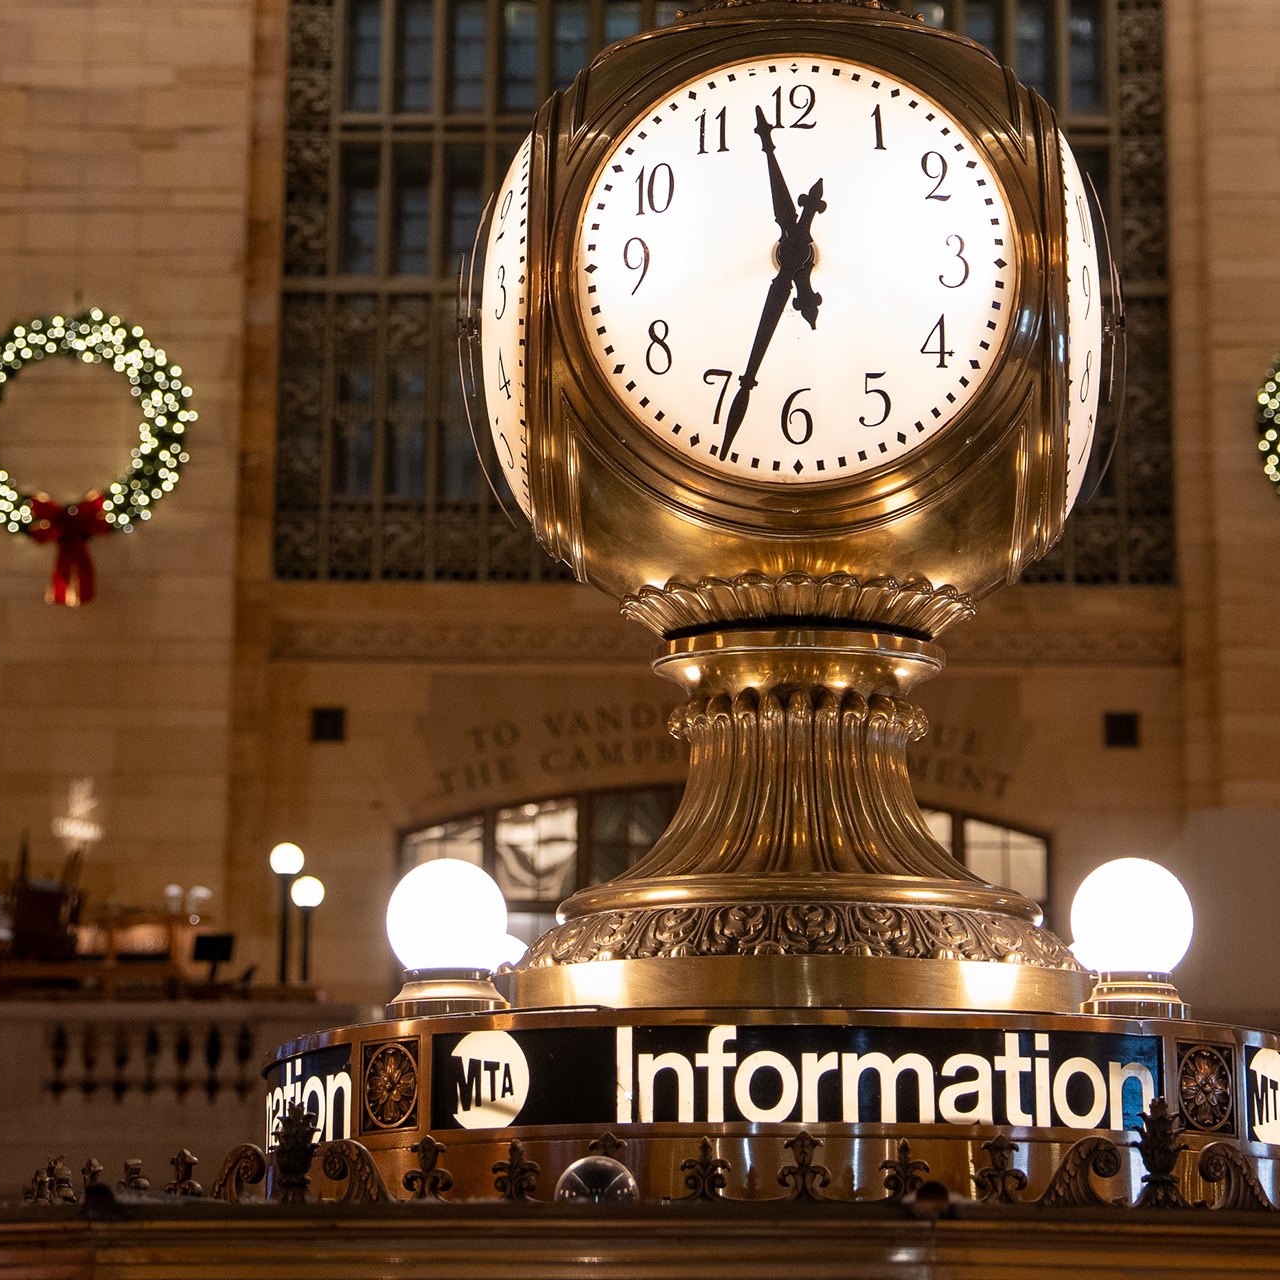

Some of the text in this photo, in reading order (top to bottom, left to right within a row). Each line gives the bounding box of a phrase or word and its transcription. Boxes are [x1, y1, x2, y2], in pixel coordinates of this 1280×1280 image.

[694, 106, 730, 155] 11
[771, 84, 817, 130] 12
[870, 103, 888, 150] 1
[635, 162, 675, 216] 10
[920, 150, 952, 202] 2
[623, 236, 650, 295] 9
[937, 233, 970, 290] 3
[494, 264, 507, 321] 3
[1081, 265, 1092, 321] 9
[645, 319, 673, 375] 8
[919, 313, 956, 369] 4
[497, 346, 513, 401] 4
[702, 368, 733, 425] 7
[858, 371, 892, 428] 5
[1080, 350, 1093, 404] 8
[780, 387, 814, 446] 6
[453, 1055, 515, 1113] MTA
[616, 1024, 1155, 1132] Information
